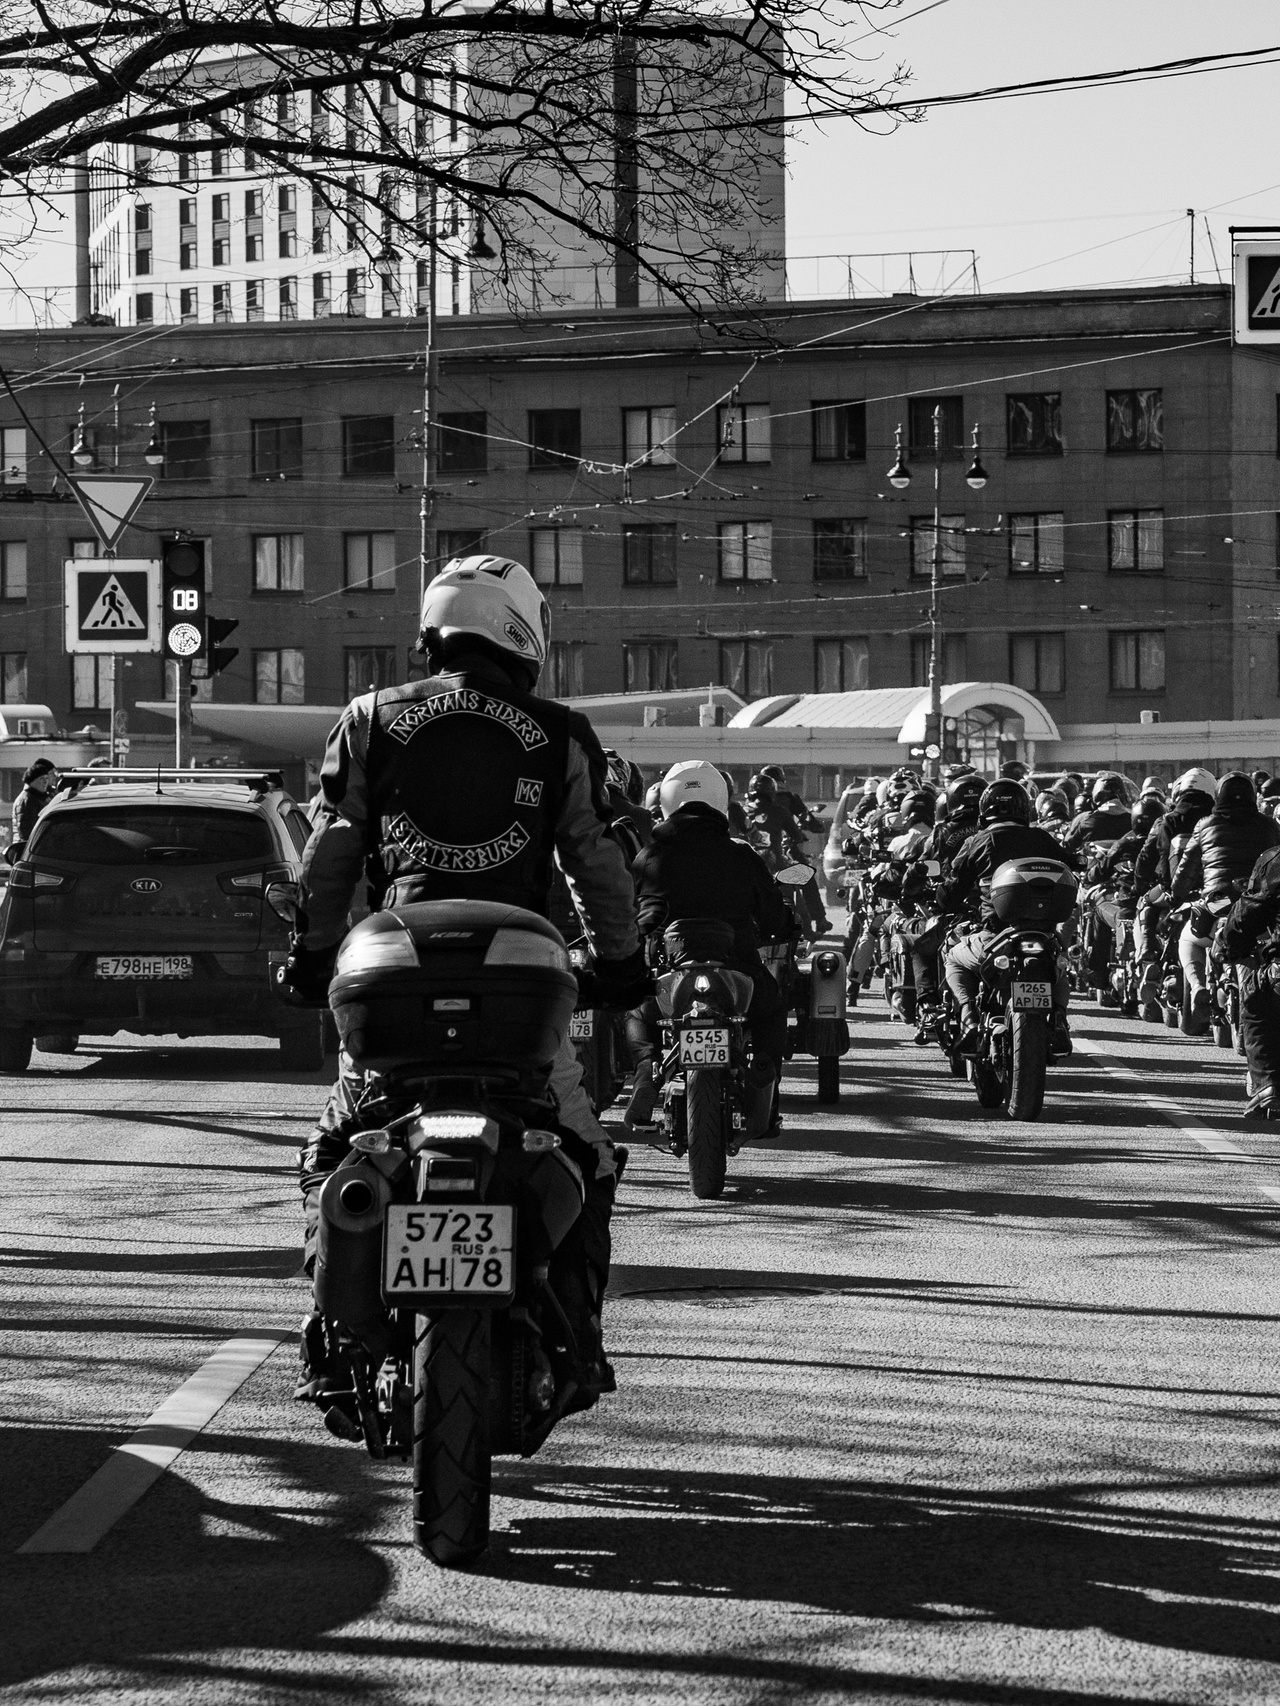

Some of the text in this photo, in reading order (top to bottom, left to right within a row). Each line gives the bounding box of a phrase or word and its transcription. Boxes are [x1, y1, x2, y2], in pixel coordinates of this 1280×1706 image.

[173, 590, 198, 610] 08
[506, 624, 527, 648] SHOEI
[393, 691, 541, 744] NORMANS RIDERS
[518, 781, 540, 803] MC
[135, 879, 158, 890] KIA
[101, 958, 189, 975] E798HE 198
[1019, 983, 1046, 993] 1265
[1015, 997, 1050, 1007] AP 78
[573, 1010, 587, 1020] 80
[575, 1024, 590, 1036] 78
[685, 1031, 723, 1044] 6545
[683, 1050, 726, 1062] AC 78
[405, 1212, 494, 1243] 5723
[452, 1244, 485, 1255] RUS
[392, 1257, 503, 1288] AH 78
